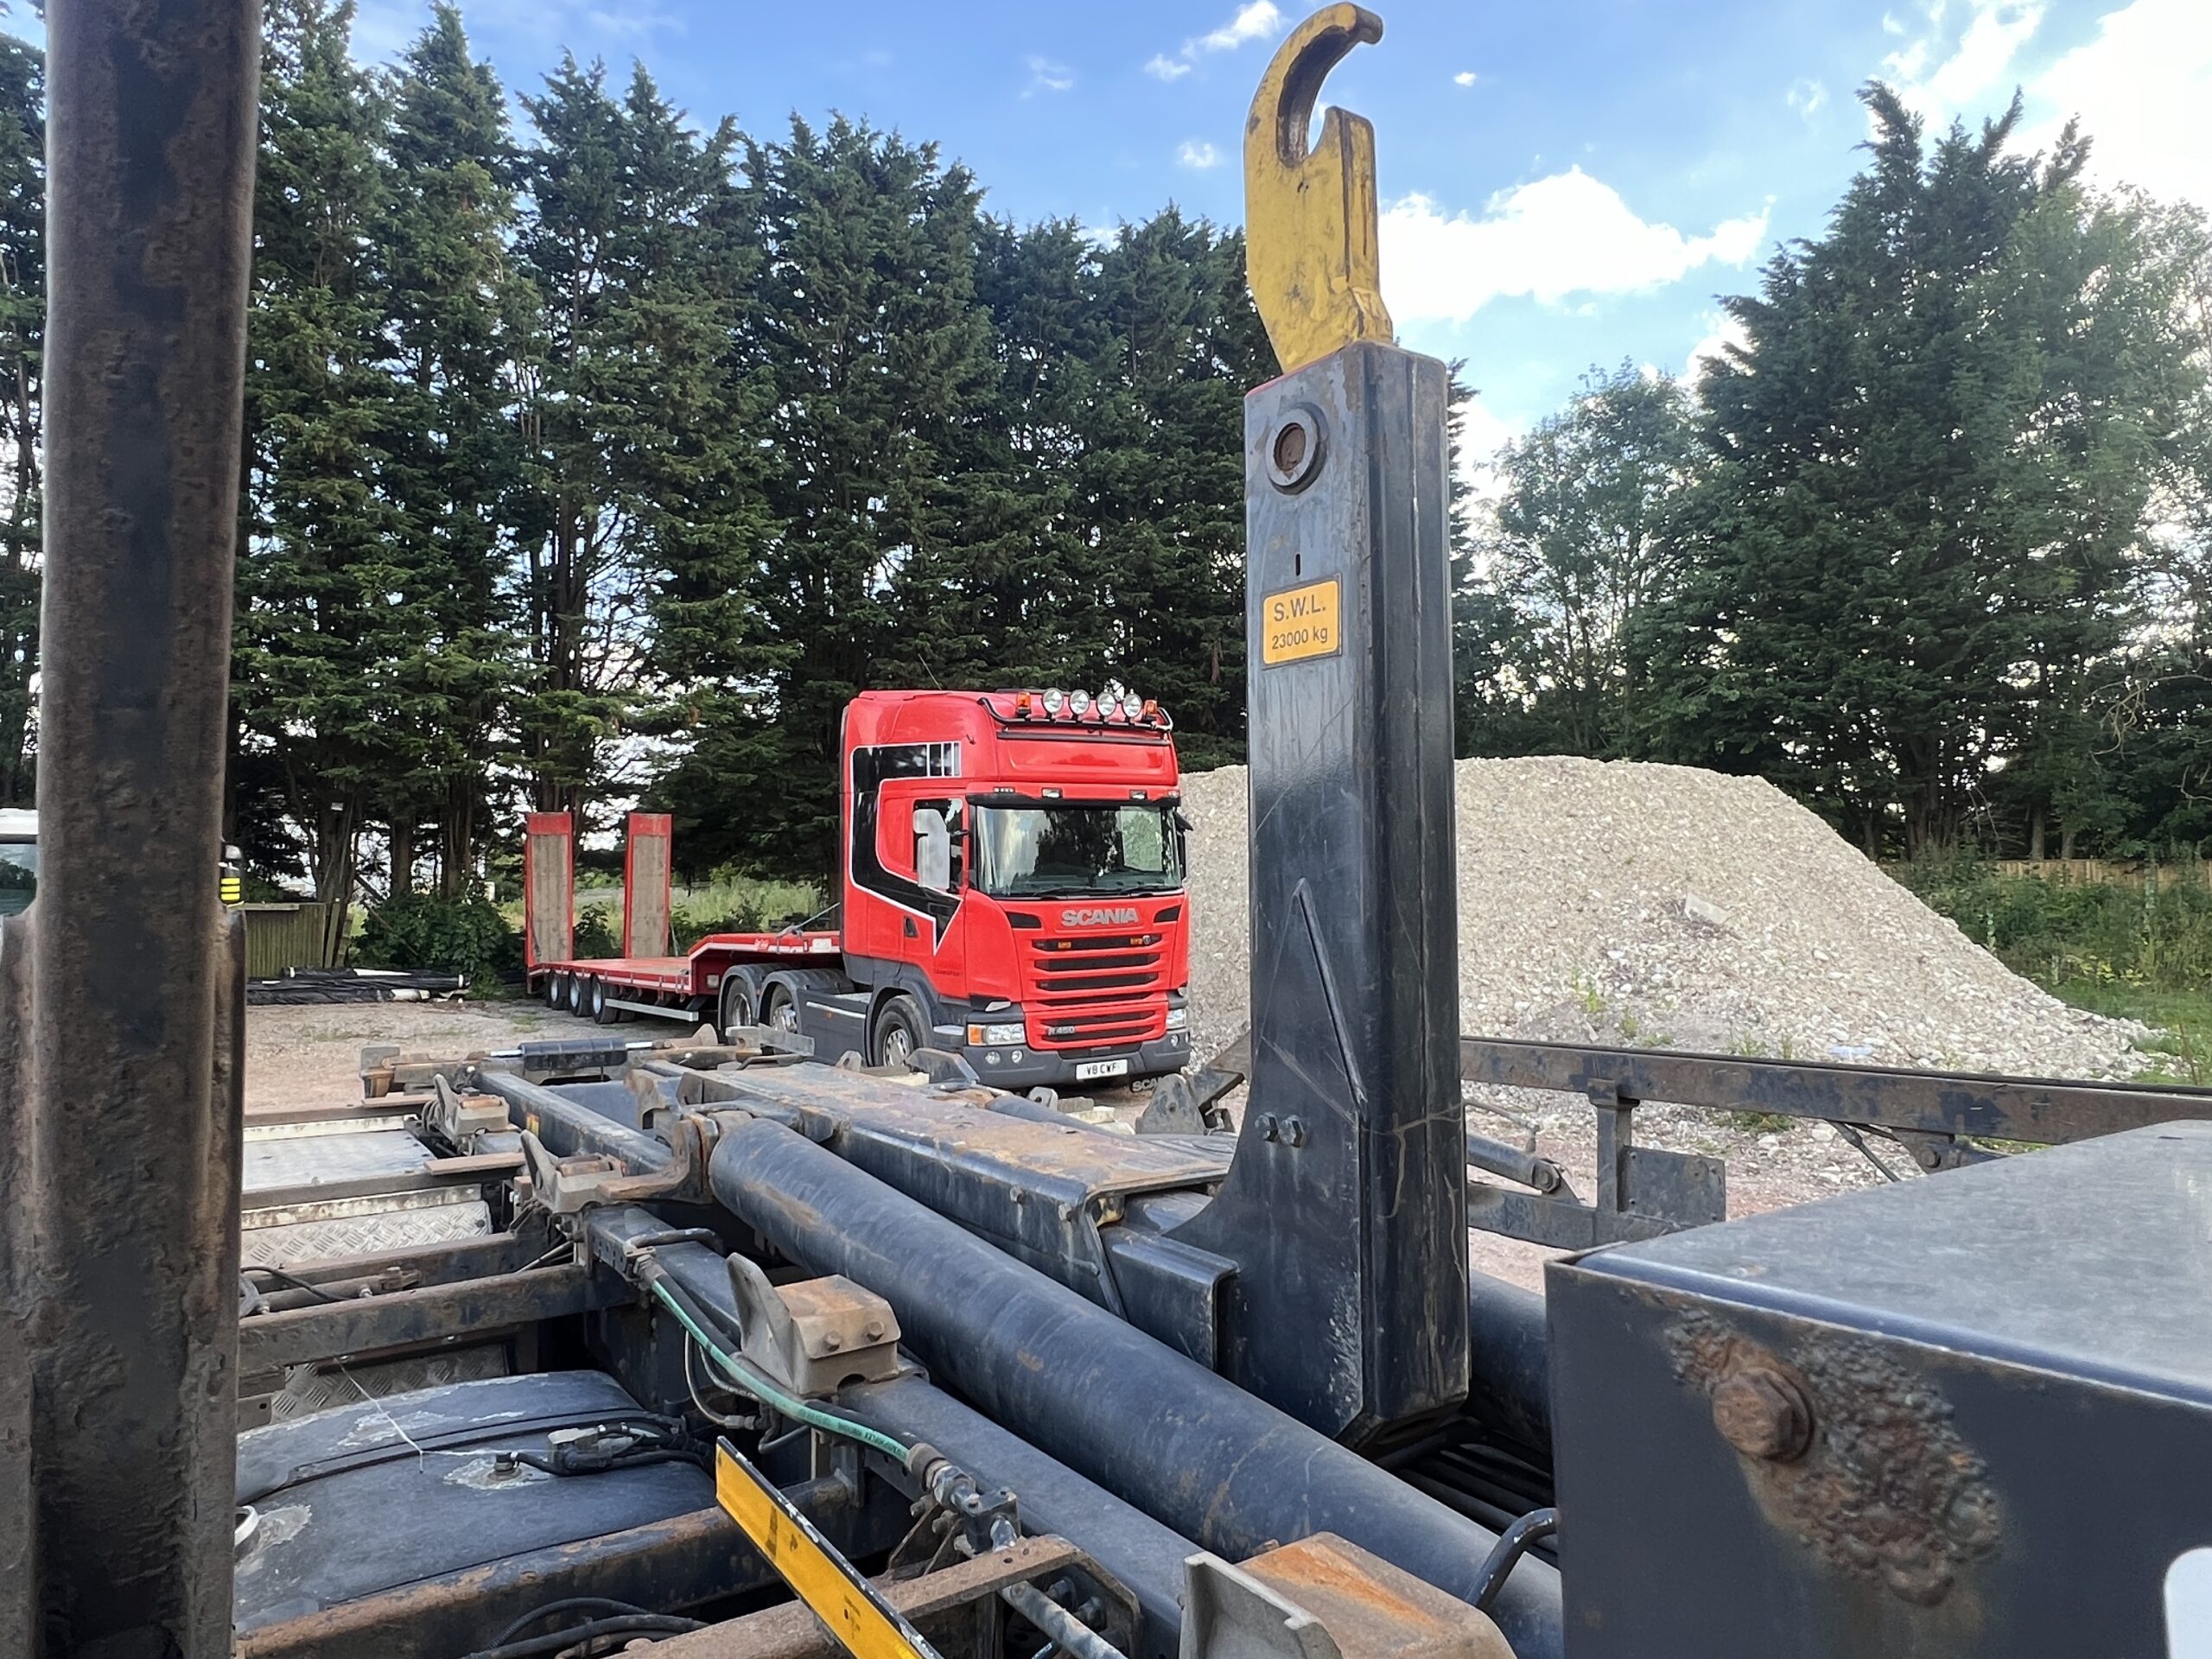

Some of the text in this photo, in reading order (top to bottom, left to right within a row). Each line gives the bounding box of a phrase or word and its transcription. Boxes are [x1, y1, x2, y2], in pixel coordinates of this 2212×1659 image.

[1274, 594, 1326, 621] S.W.L.
[1272, 626, 1328, 650] 23000 kg
[1061, 907, 1139, 926] SCANIA
[1086, 1065, 1097, 1075] V8
